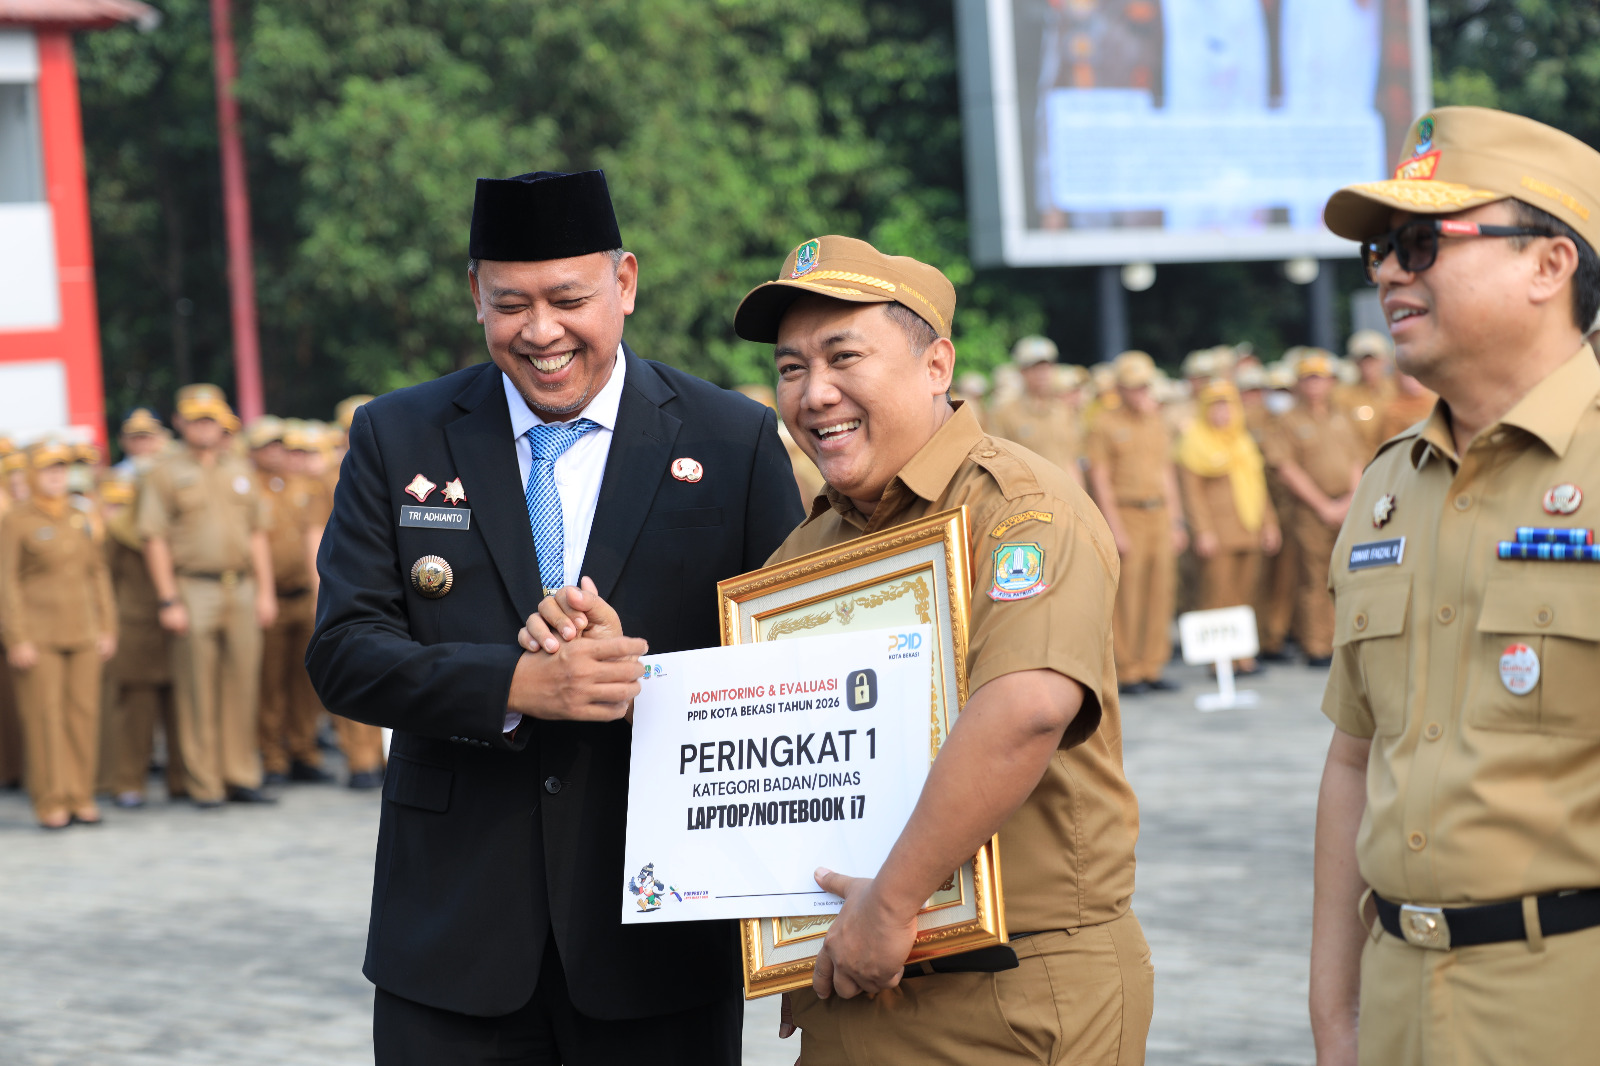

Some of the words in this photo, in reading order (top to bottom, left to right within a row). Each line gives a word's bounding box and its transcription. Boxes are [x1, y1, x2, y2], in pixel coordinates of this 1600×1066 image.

[409, 511, 421, 521] TRI
[423, 512, 463, 523] ADHIANTO
[888, 632, 922, 652] PPID
[902, 651, 920, 659] BEKASI
[690, 685, 765, 705] MONITORING
[768, 684, 776, 697] &
[779, 678, 838, 696] EVALUASI
[687, 710, 708, 722] PPID
[710, 706, 738, 720] KOTA
[740, 703, 776, 717] BEKASI
[778, 699, 813, 713] TAHUN
[815, 697, 840, 710] 2026
[679, 729, 857, 775] PERINGKAT
[866, 727, 876, 760] 1
[692, 779, 760, 798] KATEGORI
[763, 771, 861, 792] BADAN/DINAS
[687, 796, 845, 831] LAPTOP/NOTEBOOK
[850, 794, 866, 820] i7
